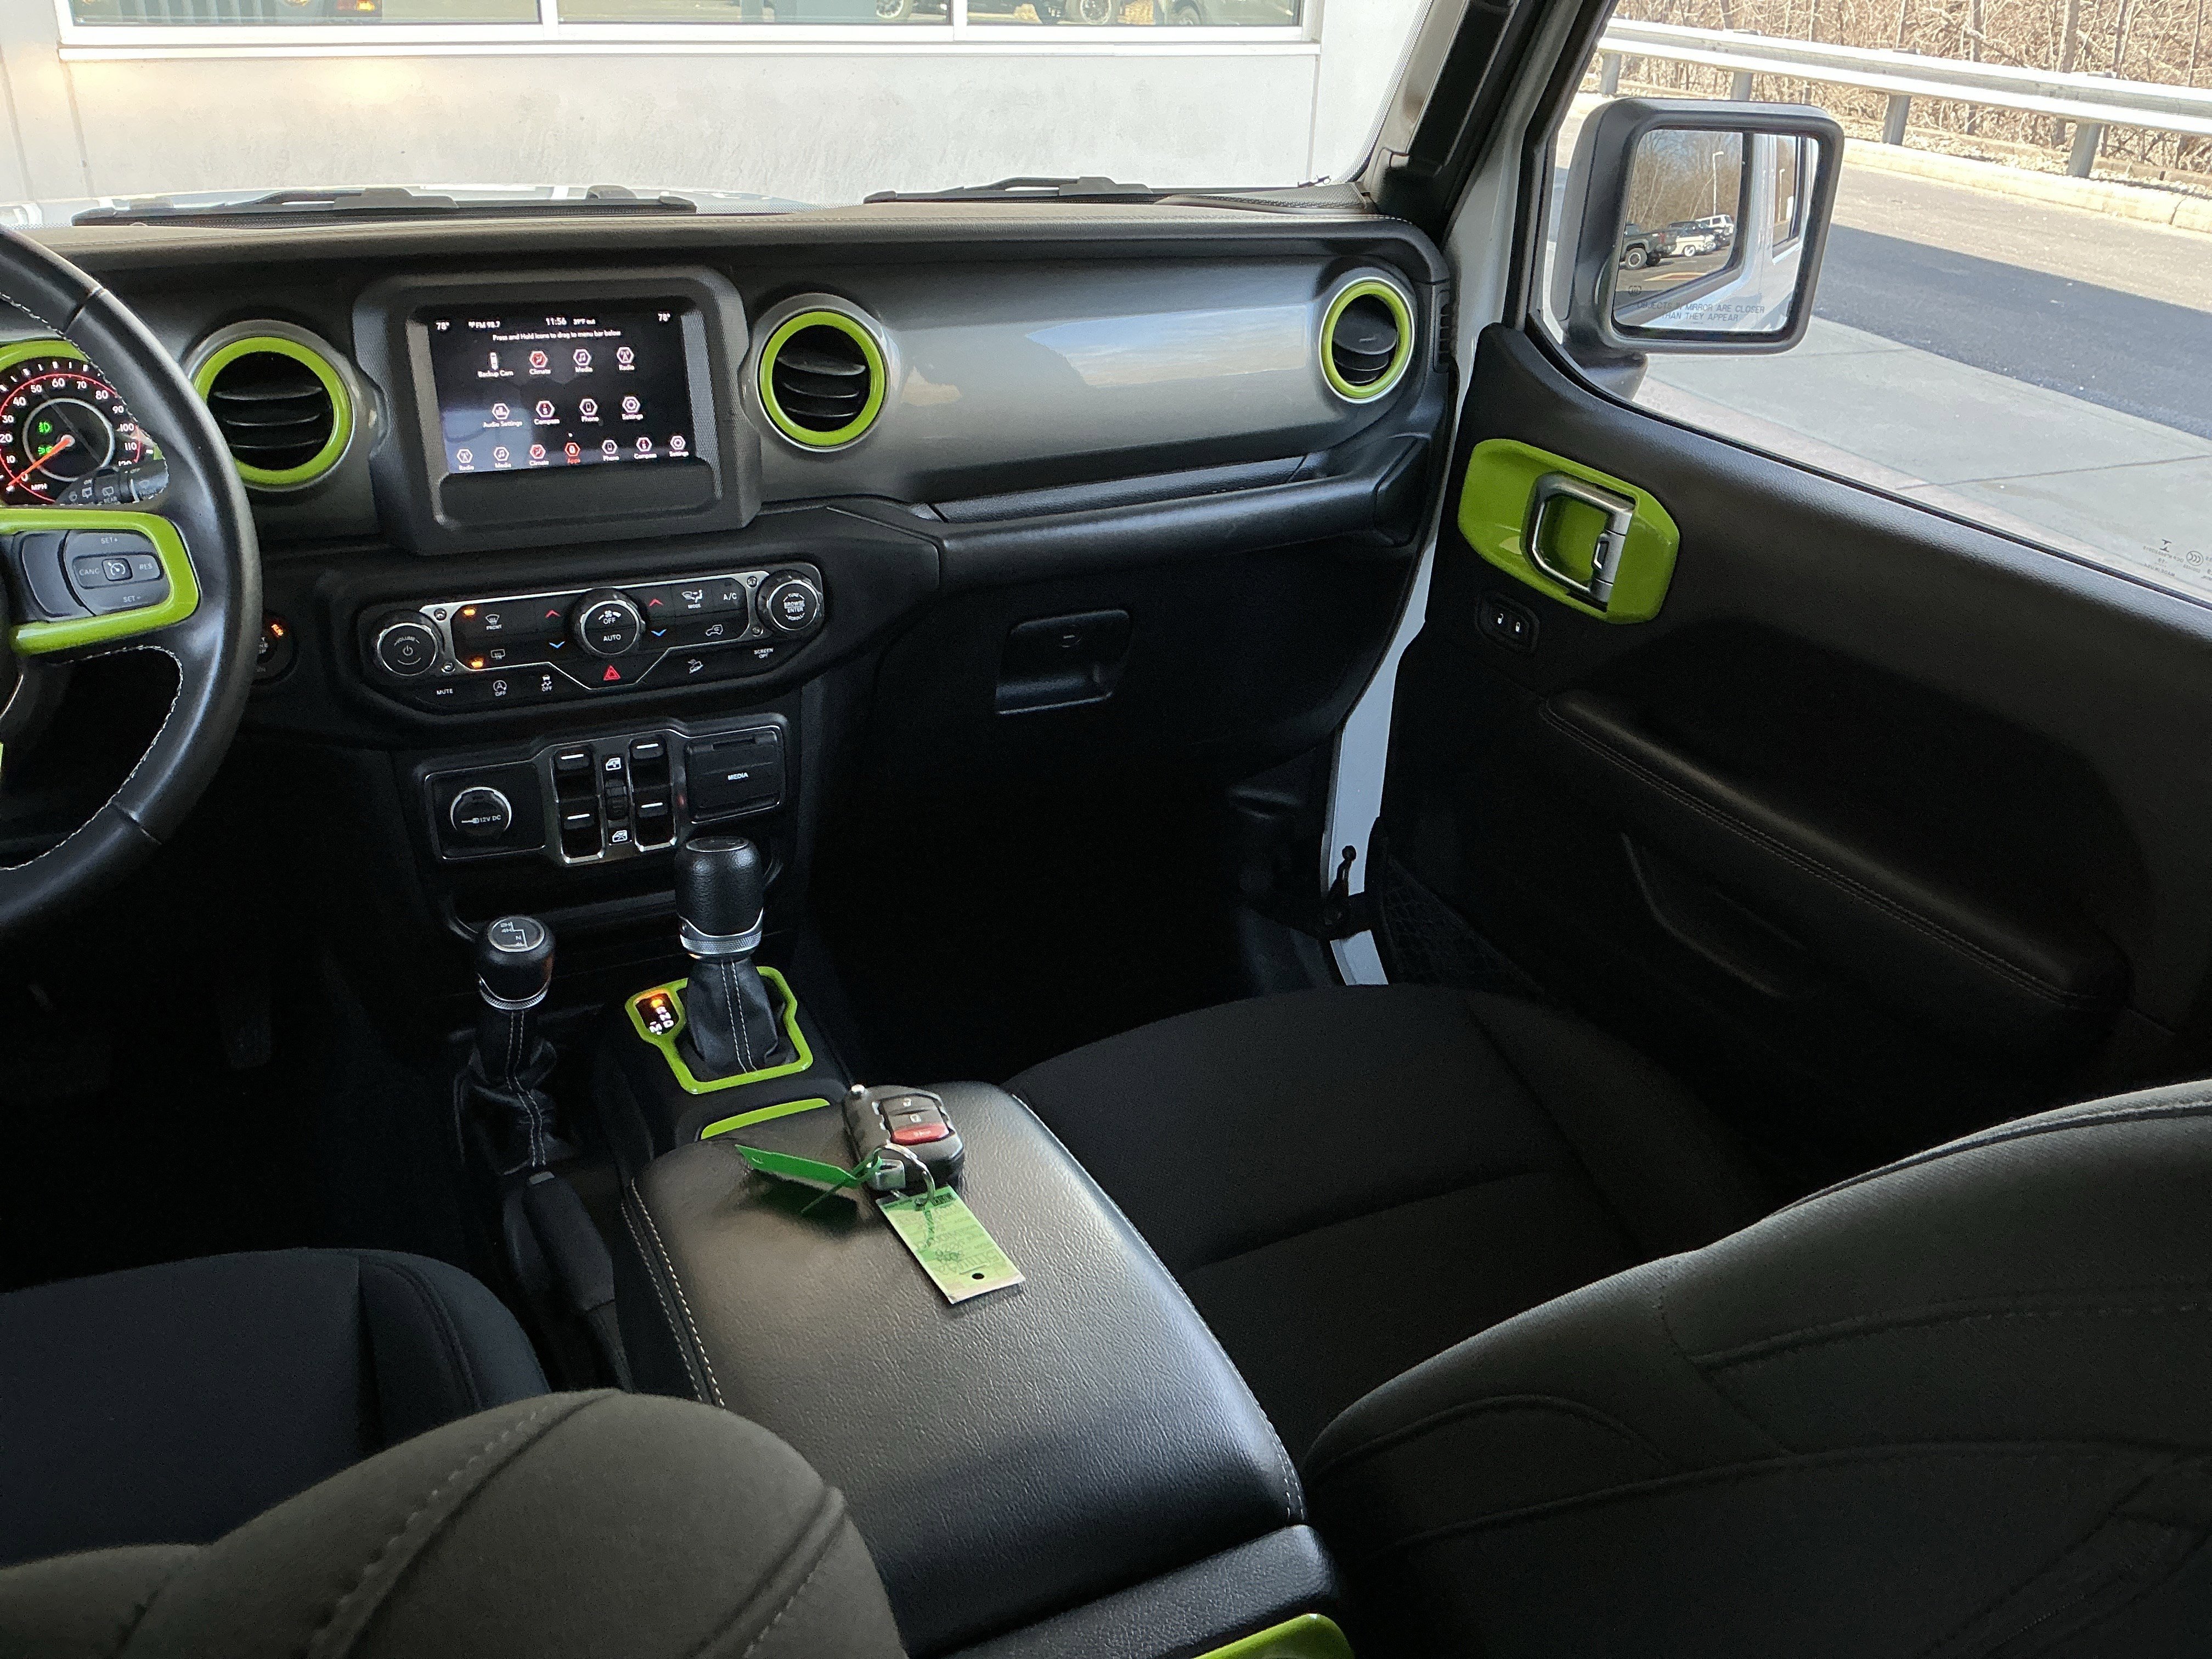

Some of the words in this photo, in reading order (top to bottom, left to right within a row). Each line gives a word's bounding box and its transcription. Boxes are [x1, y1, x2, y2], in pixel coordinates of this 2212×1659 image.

[1637, 302, 1672, 310] OBJECTS
[1735, 304, 1765, 313] CLOSER
[546, 317, 567, 325] 11:56
[1707, 313, 1739, 321] APPEAR
[52, 377, 65, 387] 60
[77, 381, 87, 389] 70
[31, 385, 42, 393] 50
[95, 390, 109, 400] 80
[13, 397, 26, 407] 40
[112, 405, 124, 414] 90
[2, 415, 14, 424] 30
[120, 423, 134, 432] 100
[0, 433, 13, 443] 20
[125, 442, 137, 451] 110
[6, 455, 16, 464] 10
[723, 592, 737, 601] A/C
[784, 600, 805, 609] BROWSE
[603, 634, 621, 642] AUTO
